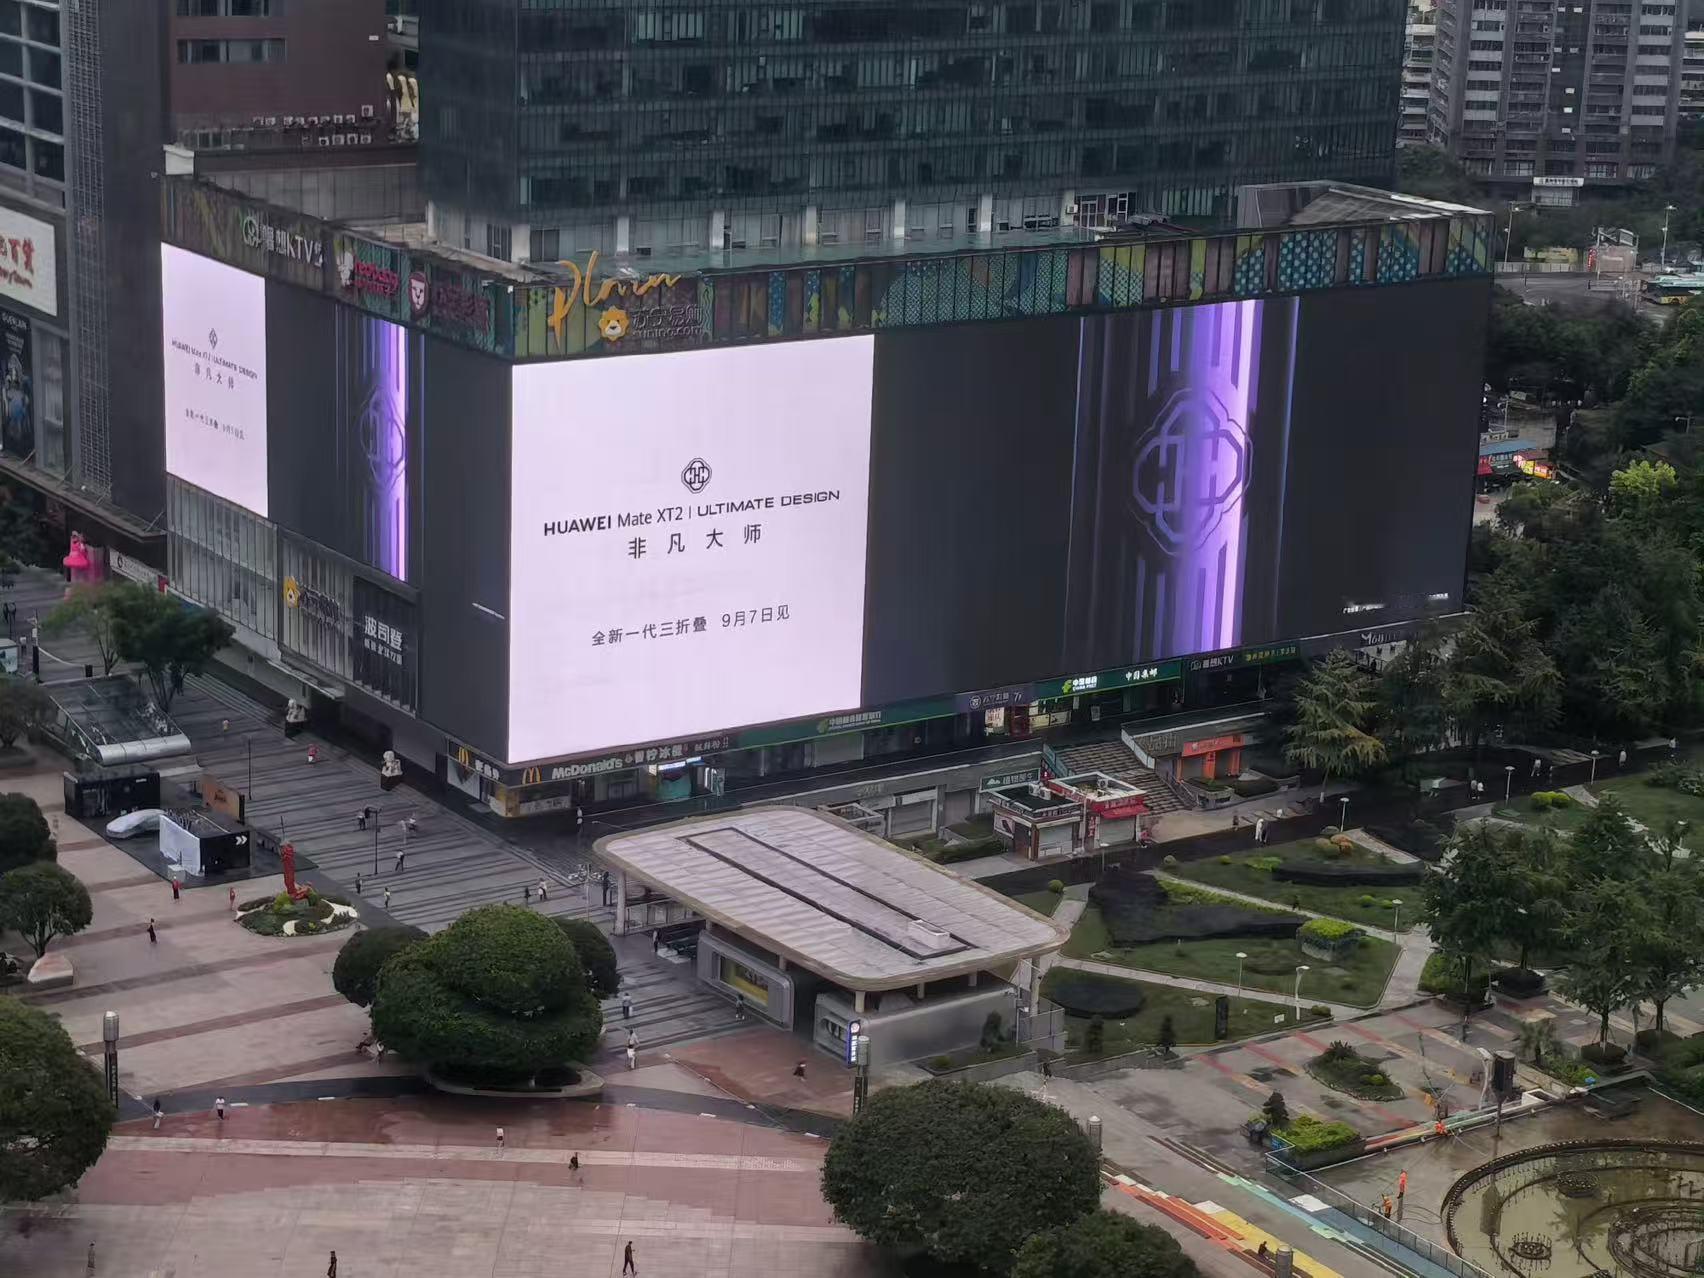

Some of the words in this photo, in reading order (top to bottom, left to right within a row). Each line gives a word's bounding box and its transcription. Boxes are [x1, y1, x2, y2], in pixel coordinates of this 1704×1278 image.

[544, 515, 611, 536] HUAWEI
[617, 512, 652, 528] Mate
[656, 506, 683, 523] XT2
[697, 497, 775, 516] ULTIMATE
[780, 490, 840, 507] DESIGN
[628, 524, 762, 559] 非凡大师
[365, 615, 402, 651] 波司登
[591, 616, 708, 646] 全新一代三折叠
[721, 604, 790, 628] 9月7日见
[552, 757, 623, 780] McDonald's
